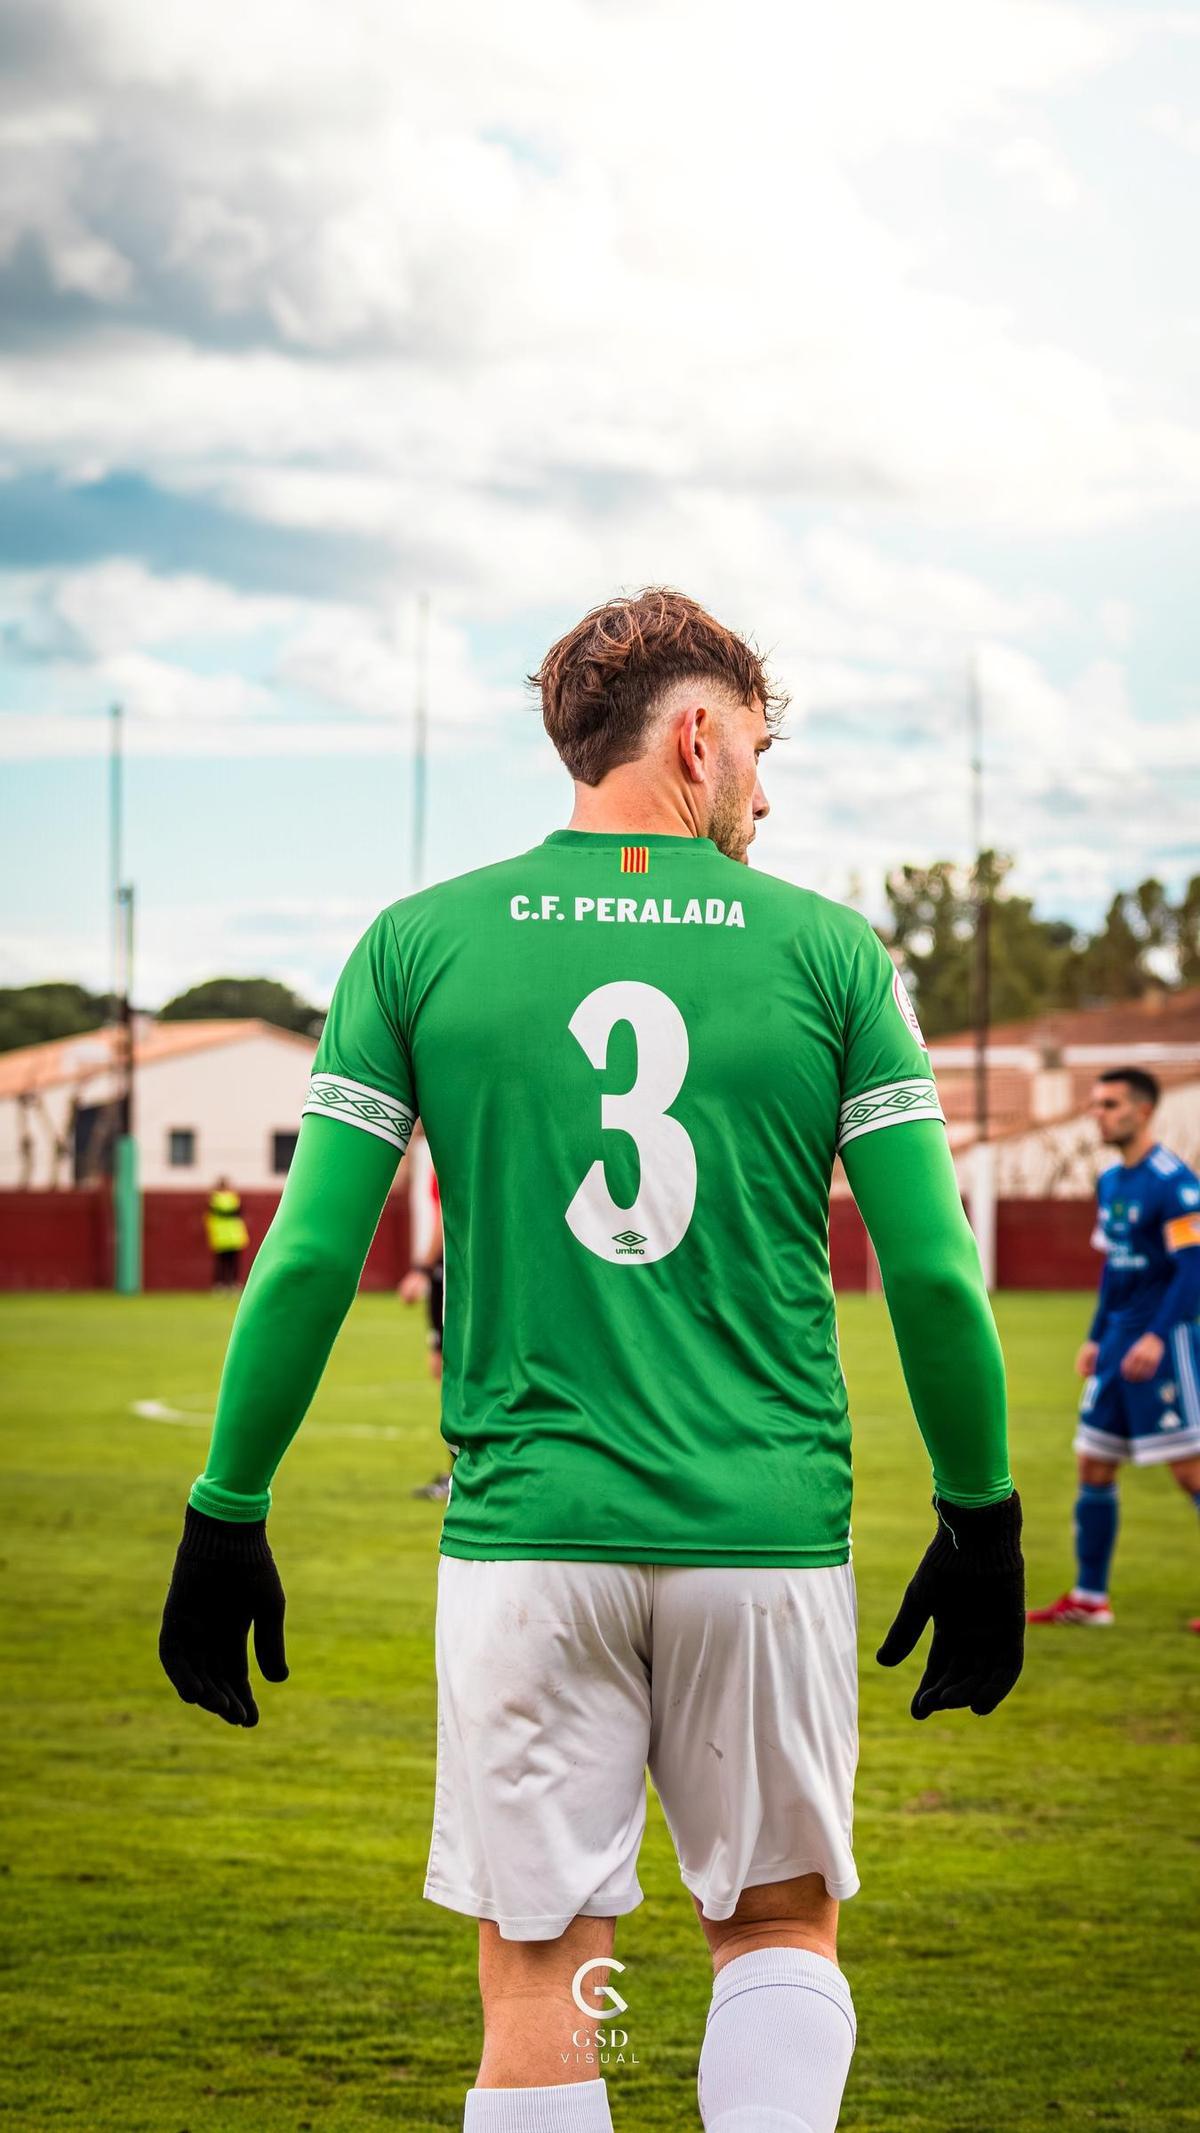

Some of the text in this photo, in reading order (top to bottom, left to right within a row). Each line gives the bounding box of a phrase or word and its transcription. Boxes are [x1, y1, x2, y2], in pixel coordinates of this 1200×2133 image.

[510, 895, 746, 929] C.F. PERALADA
[564, 980, 698, 1266] 3
[615, 1247, 645, 1255] umbro
